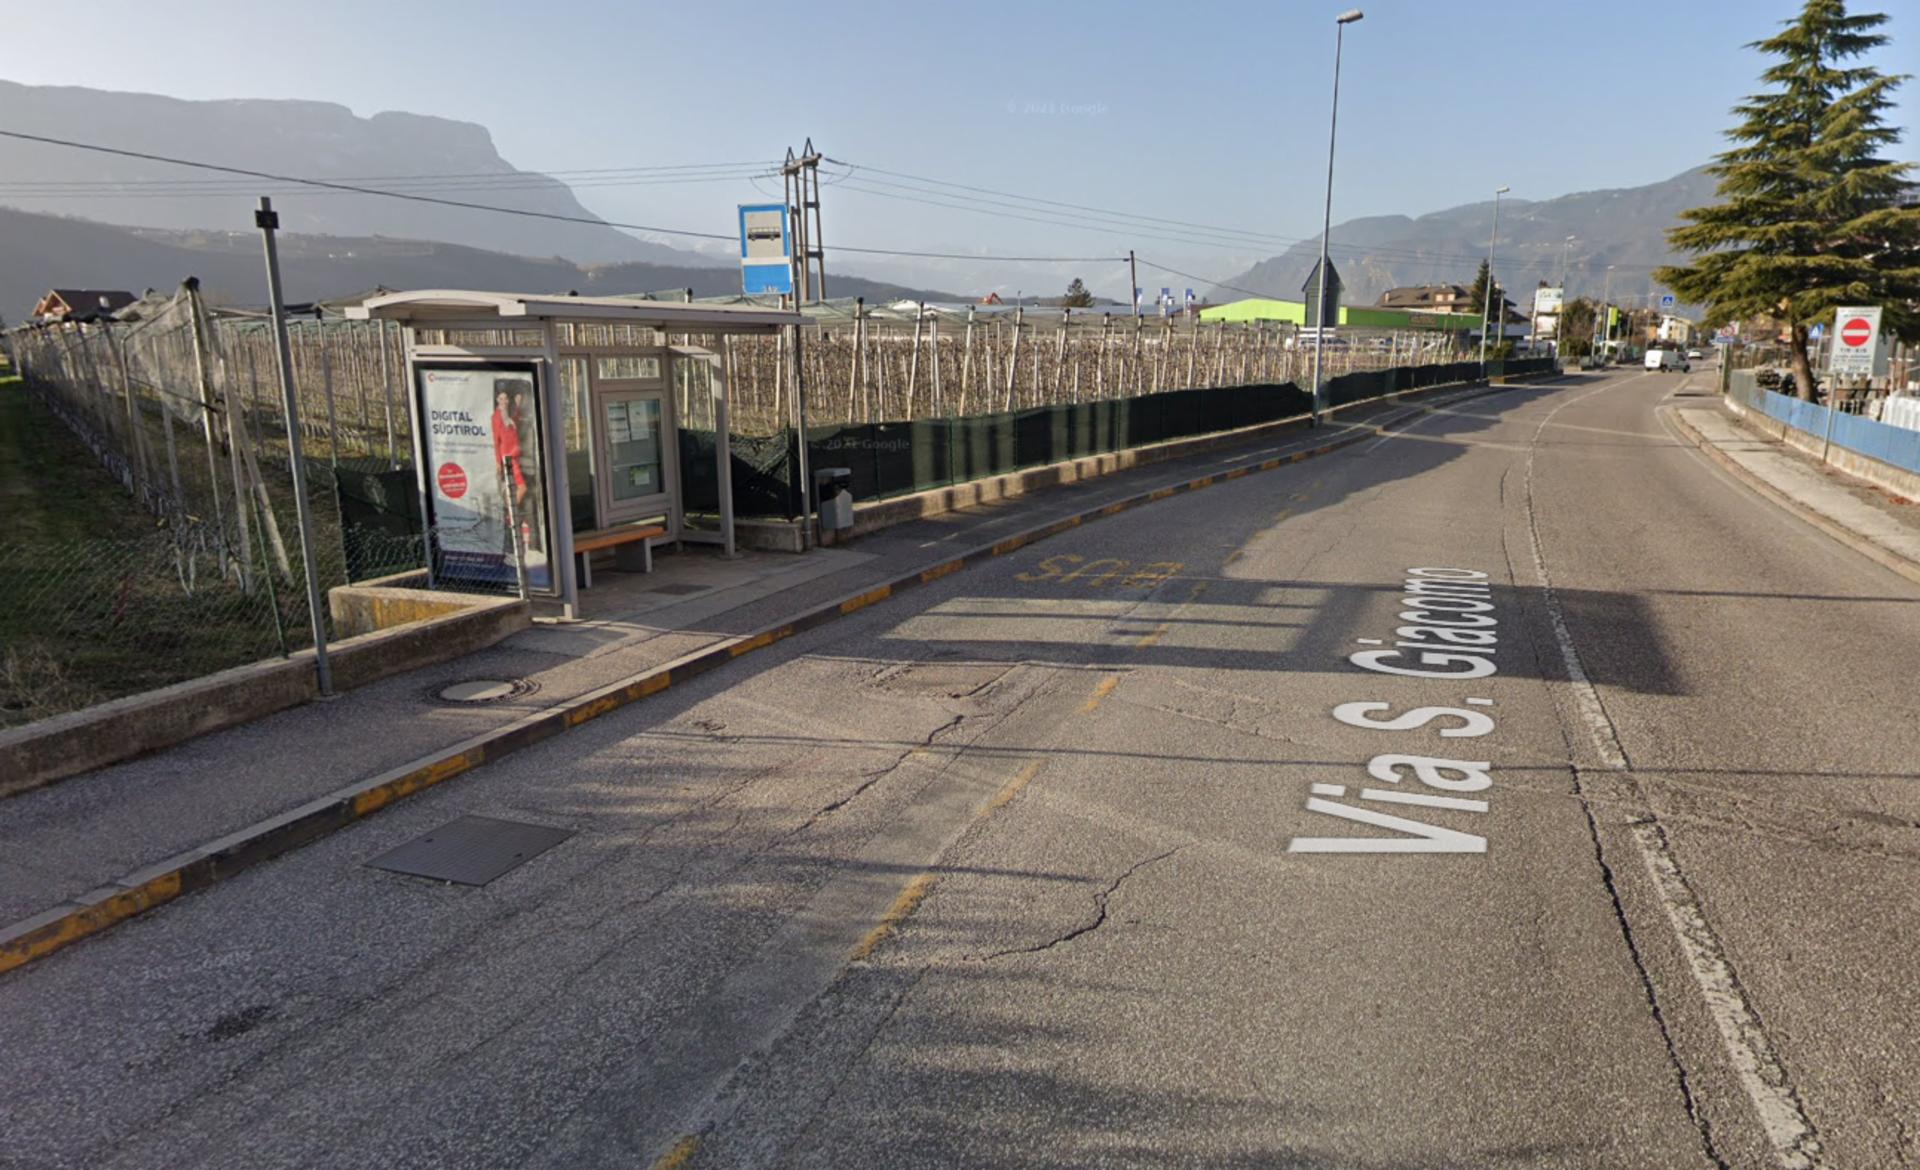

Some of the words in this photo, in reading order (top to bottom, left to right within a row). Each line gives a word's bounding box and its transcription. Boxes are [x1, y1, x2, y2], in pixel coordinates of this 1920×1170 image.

[431, 410, 473, 422] DIGITAL
[432, 421, 487, 436] SÜDTIROL
[1014, 554, 1185, 589] BUS
